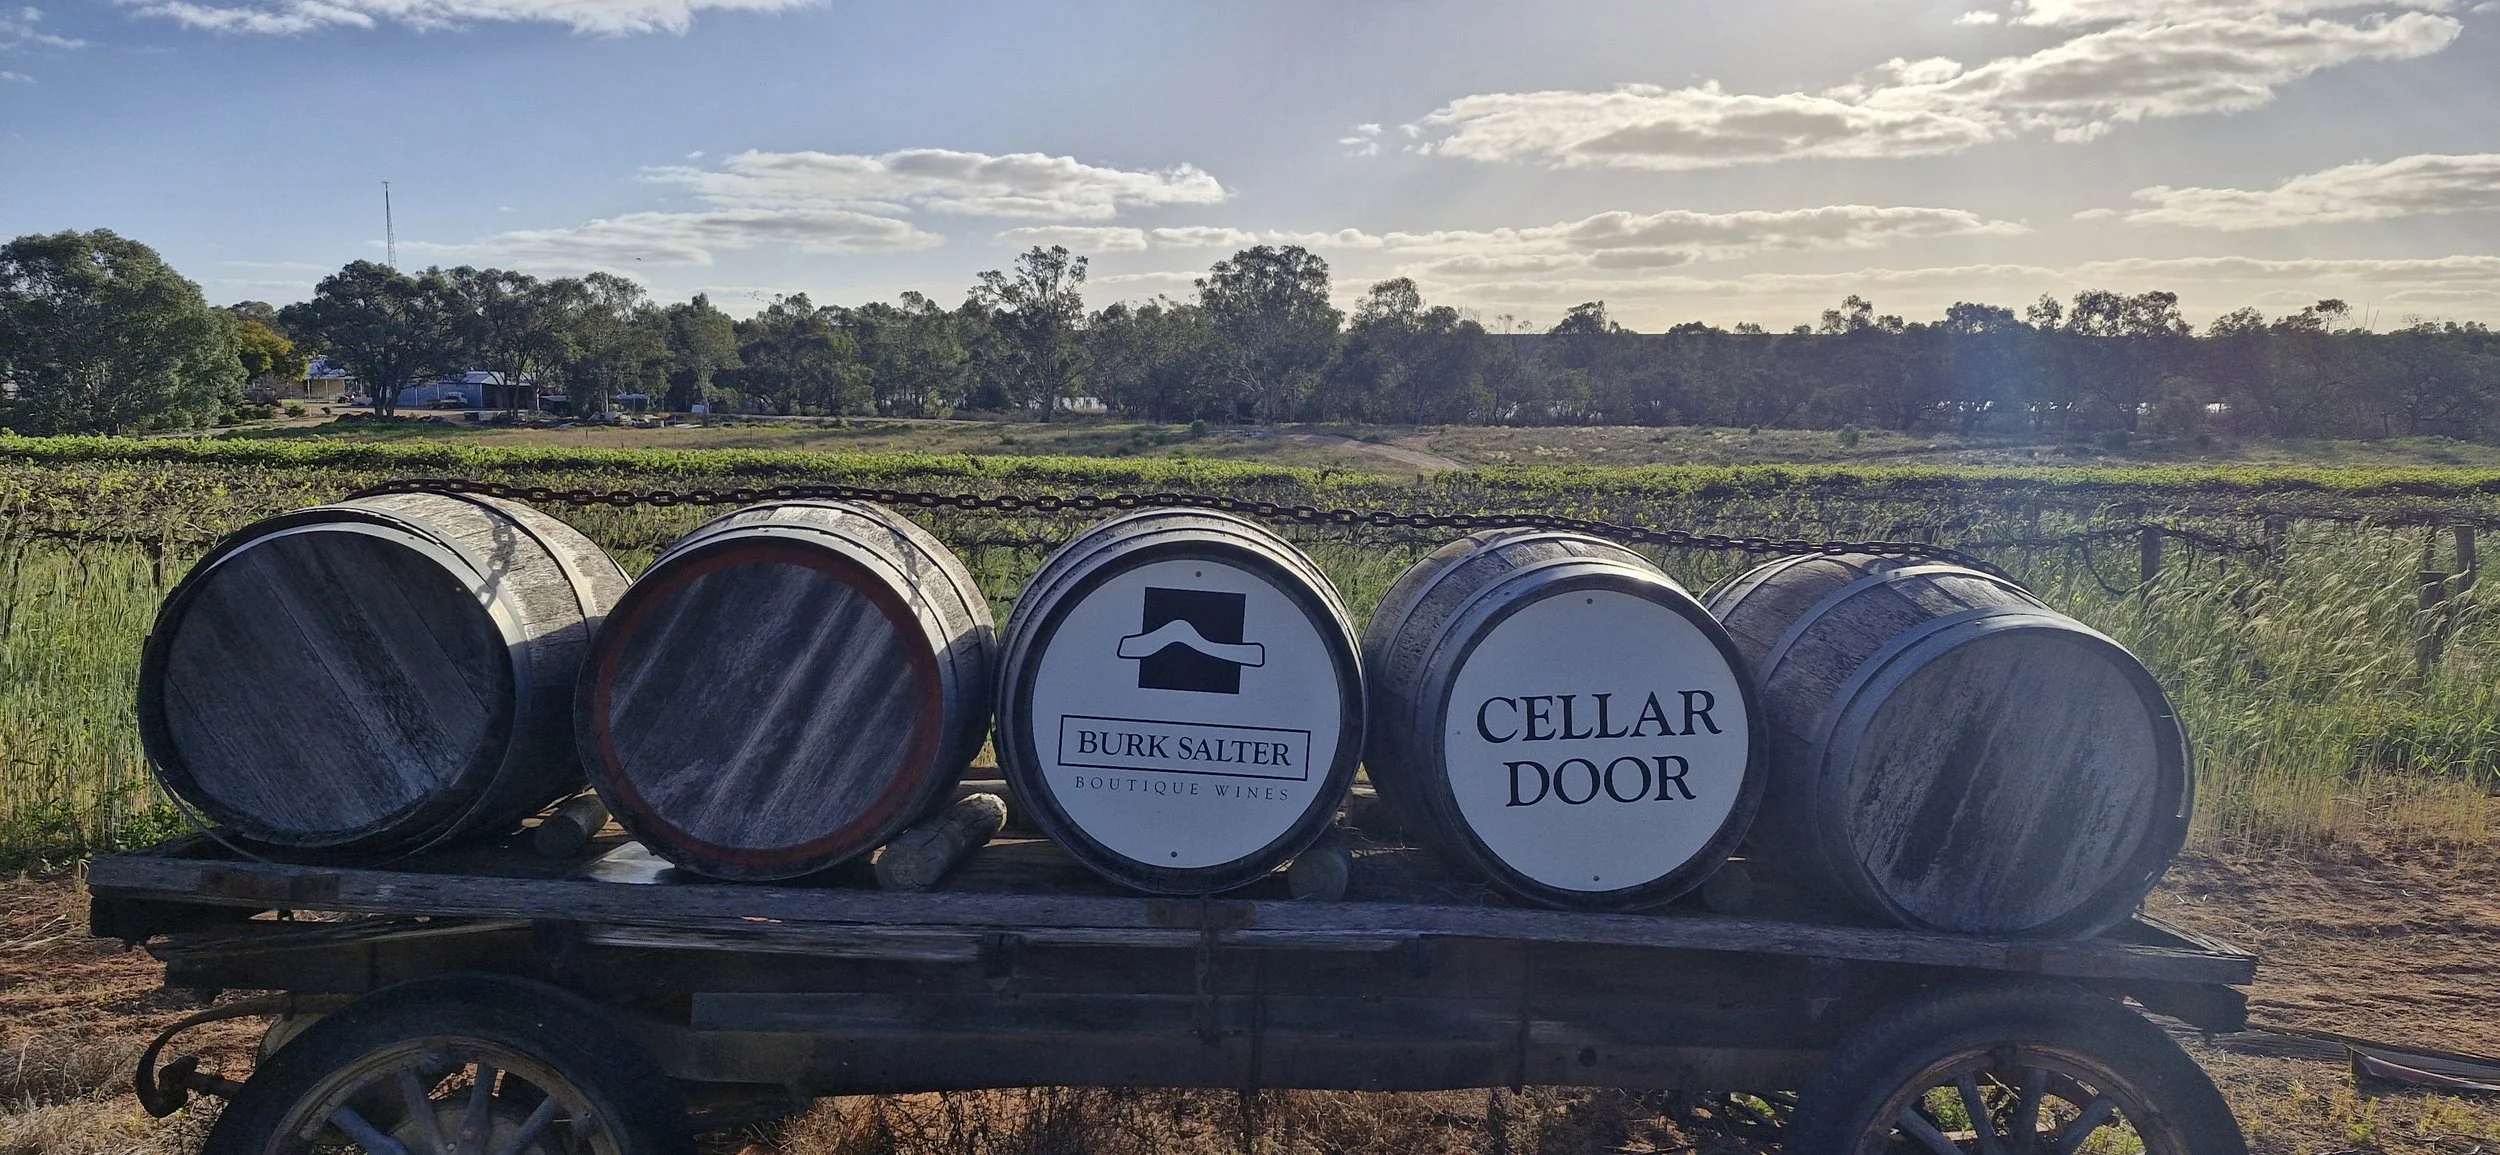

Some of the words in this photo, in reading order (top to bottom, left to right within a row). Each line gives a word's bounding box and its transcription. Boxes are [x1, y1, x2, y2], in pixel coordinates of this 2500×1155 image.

[1476, 690, 1722, 744] CELLAR
[1078, 730, 1170, 759] BURK
[1177, 736, 1292, 766] SALTER
[1075, 776, 1199, 795] BOUTIQUE
[1215, 784, 1289, 801] WINES
[1502, 755, 1697, 807] DOOR
